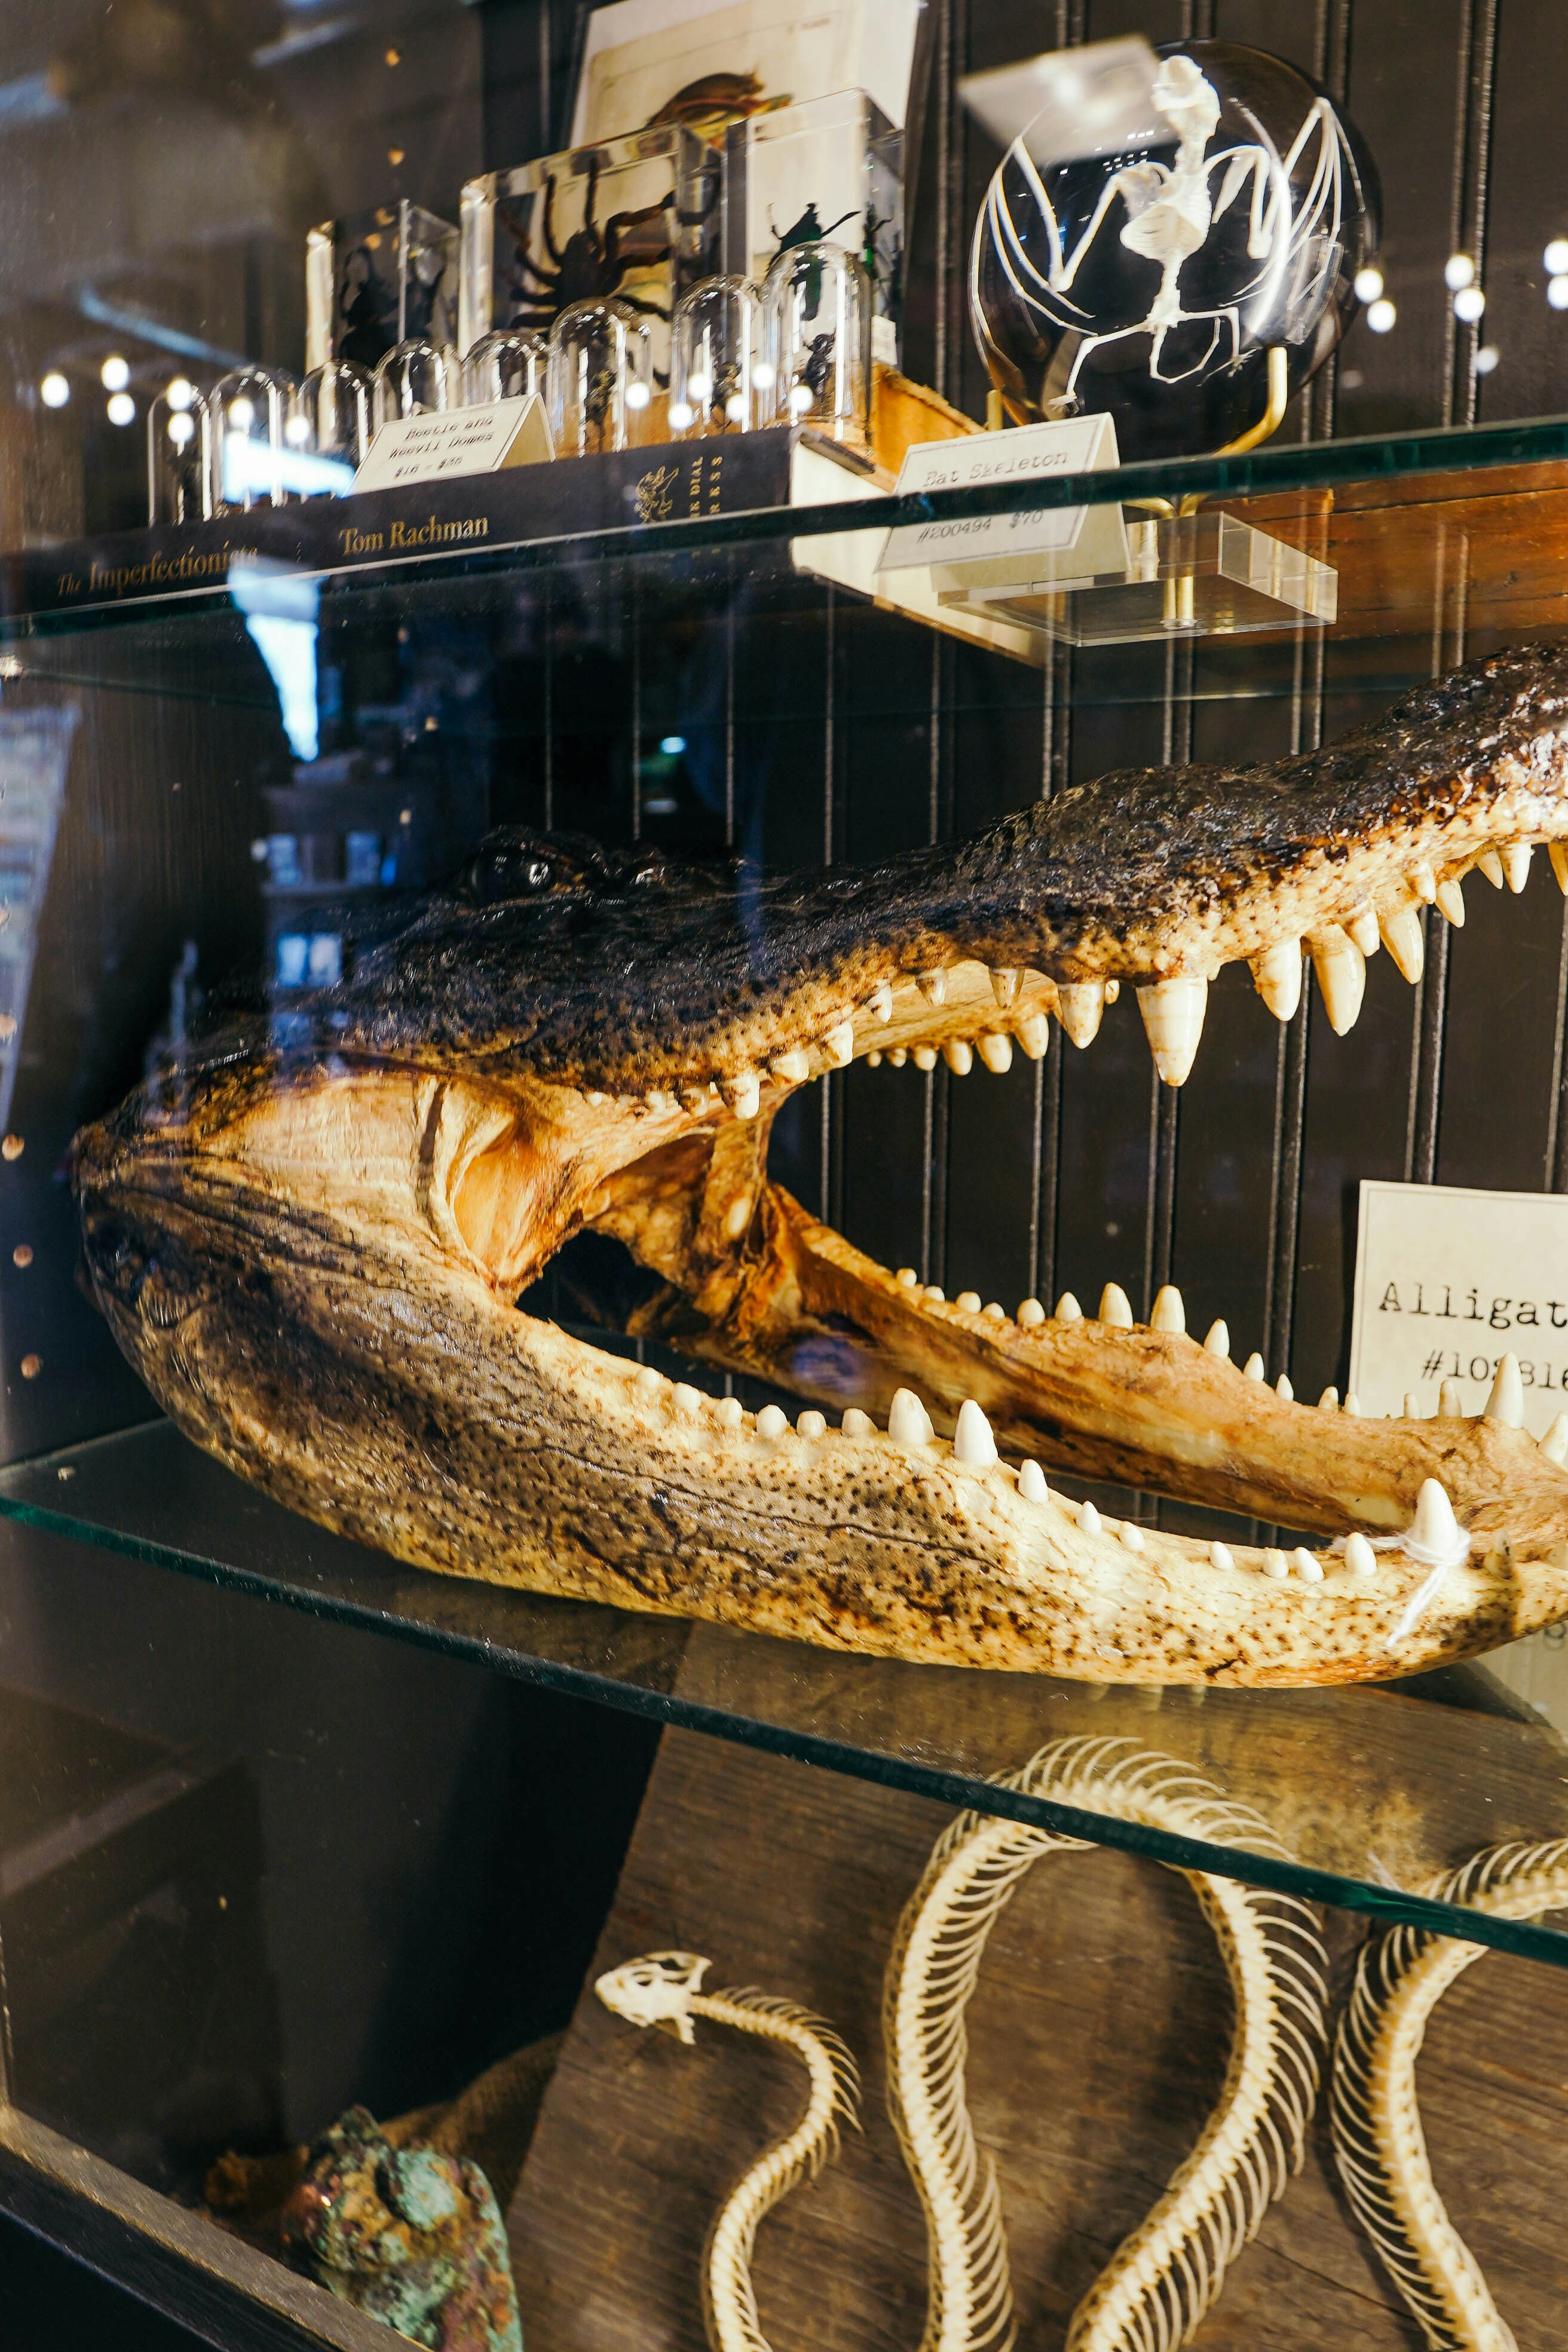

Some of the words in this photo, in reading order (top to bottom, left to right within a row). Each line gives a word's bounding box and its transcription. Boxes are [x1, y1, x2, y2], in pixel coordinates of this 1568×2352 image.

[404, 422, 460, 442] Beetle
[464, 415, 494, 430] and
[447, 431, 495, 449] Domes
[709, 456, 723, 514] RESS
[922, 470, 960, 487] Bat
[969, 452, 1068, 480] Skeleton
[339, 527, 384, 556] Tom
[389, 514, 489, 549] Rachman
[916, 517, 992, 544] #200494
[1008, 509, 1043, 529] $70
[57, 572, 82, 596] The
